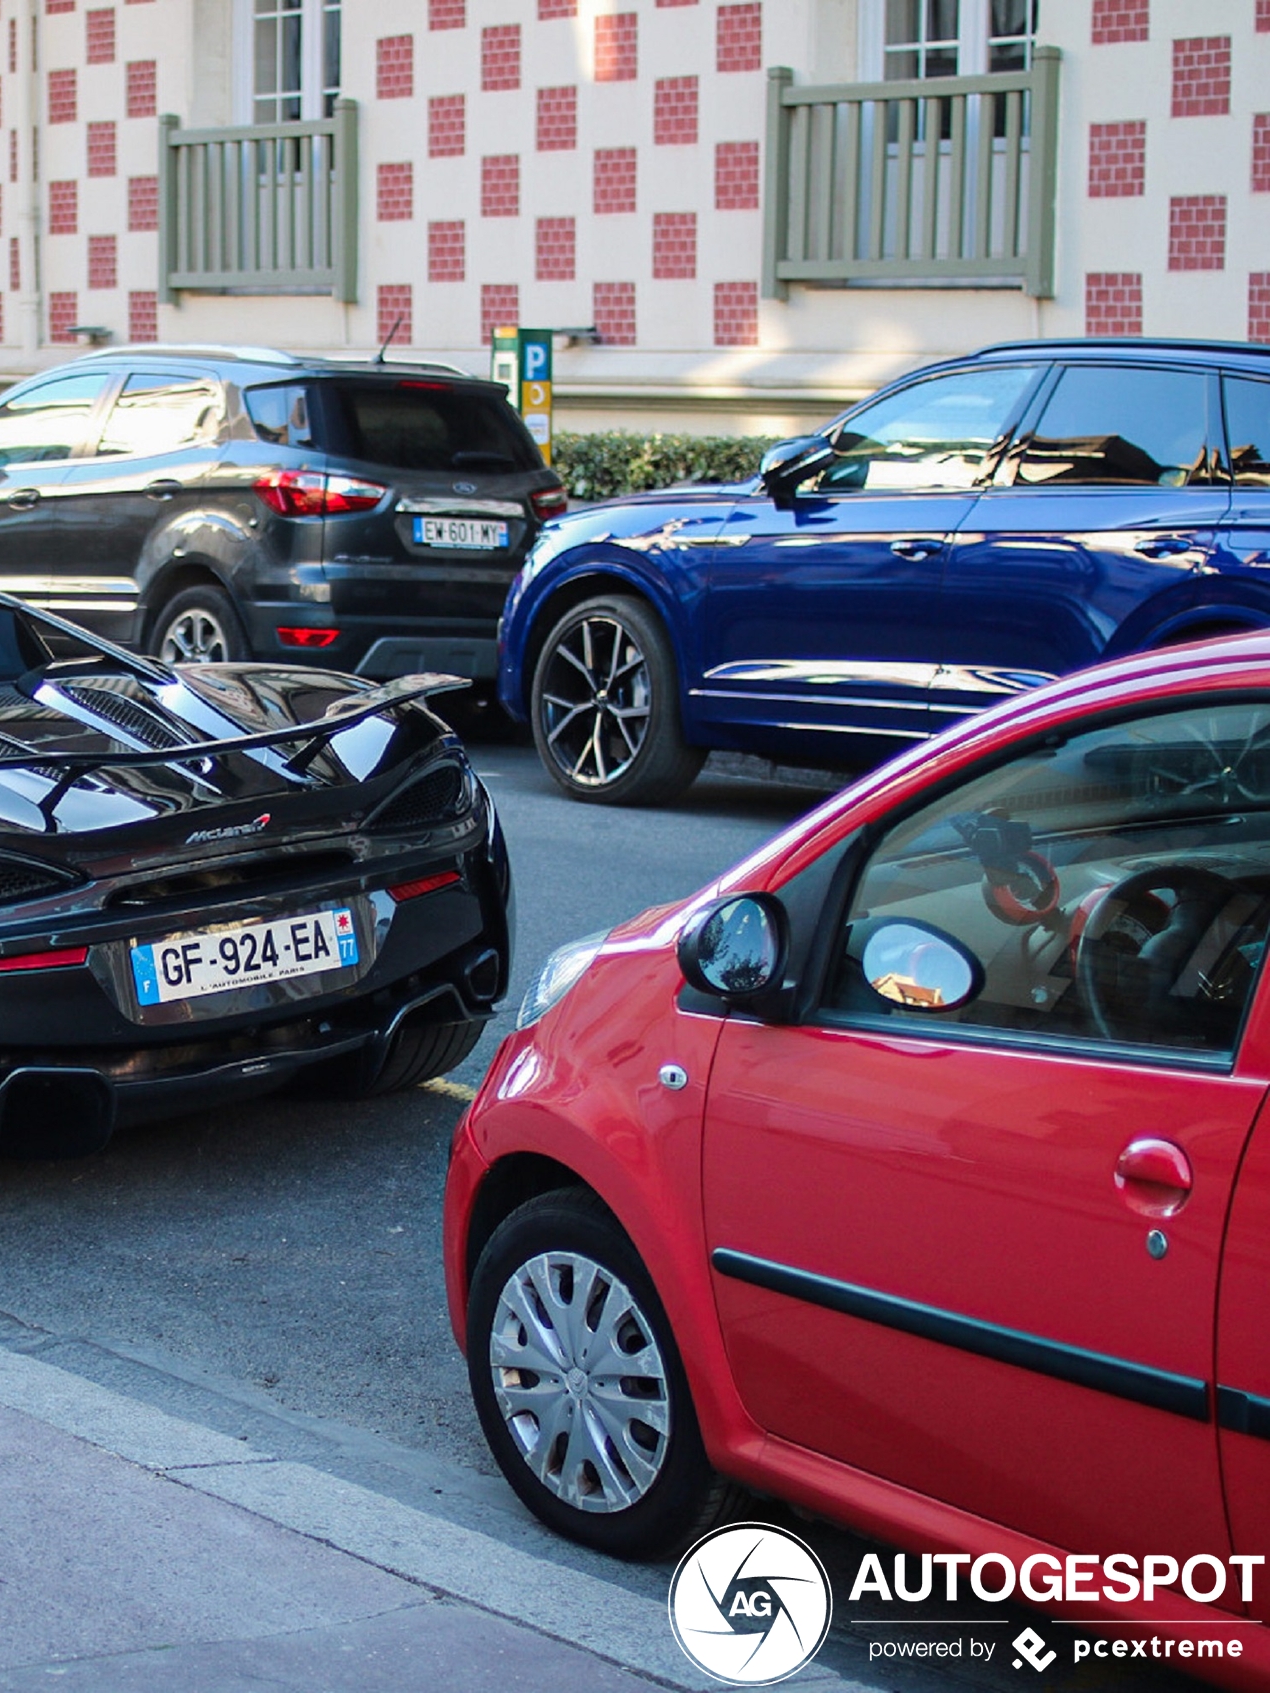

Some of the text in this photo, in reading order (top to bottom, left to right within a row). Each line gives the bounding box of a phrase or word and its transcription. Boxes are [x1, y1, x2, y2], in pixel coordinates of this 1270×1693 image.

[526, 344, 545, 380] P
[161, 919, 331, 987] GF-924-EA
[339, 938, 355, 960] 77
[278, 965, 306, 977] PARIS
[142, 980, 151, 994] F
